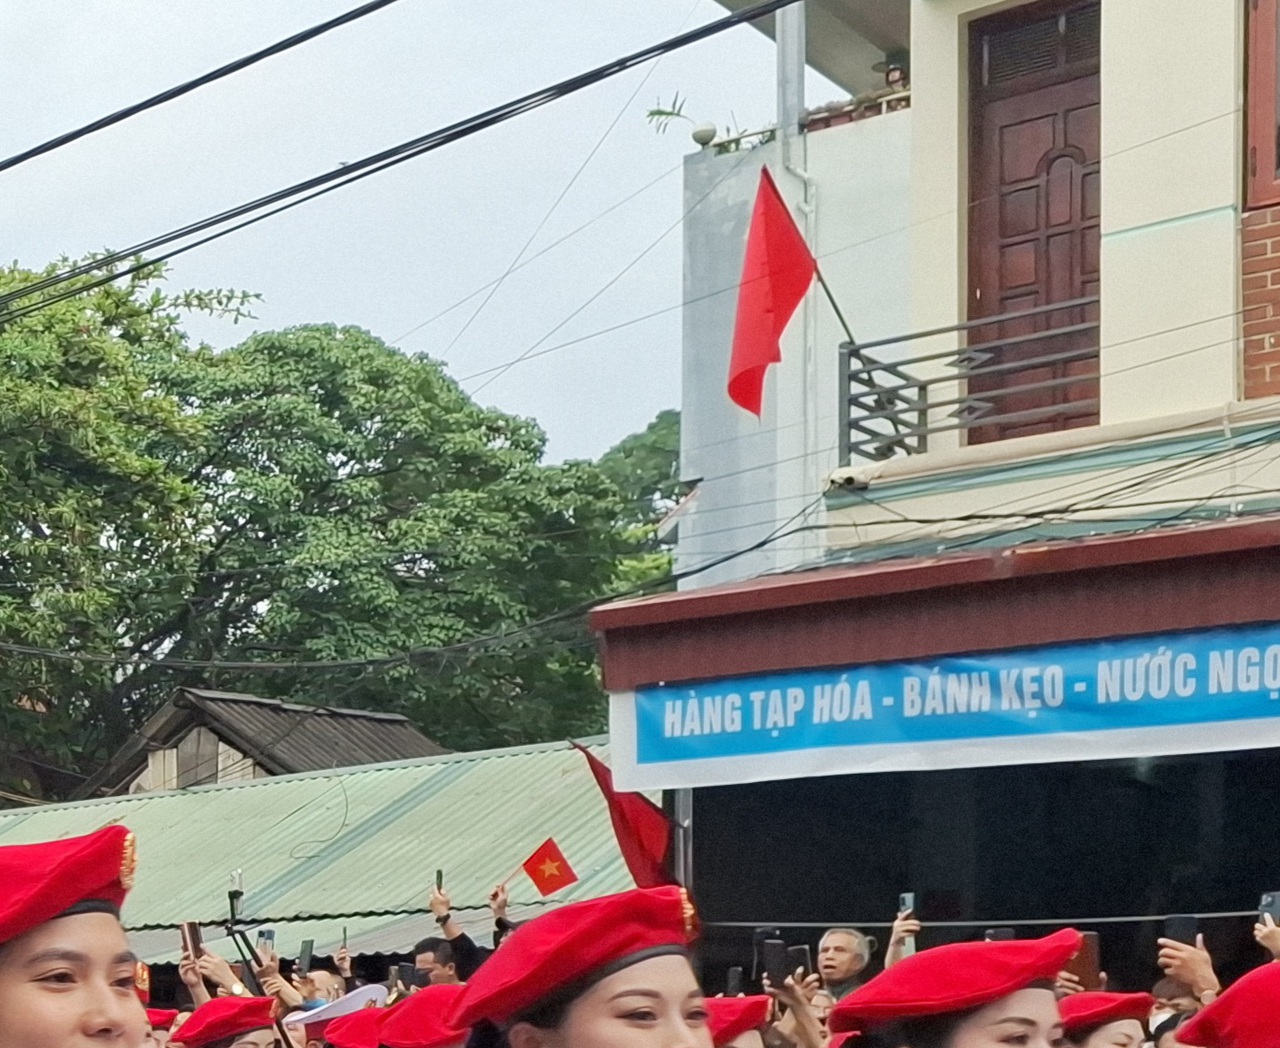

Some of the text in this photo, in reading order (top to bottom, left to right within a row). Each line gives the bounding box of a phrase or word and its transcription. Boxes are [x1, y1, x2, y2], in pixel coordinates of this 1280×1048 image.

[664, 690, 742, 737] HÀNG
[749, 687, 805, 737] TẠP
[812, 674, 873, 724] HÓA
[903, 666, 991, 717] BÁNH
[999, 665, 1064, 718] KẸO
[1097, 646, 1197, 703] NƯỚC
